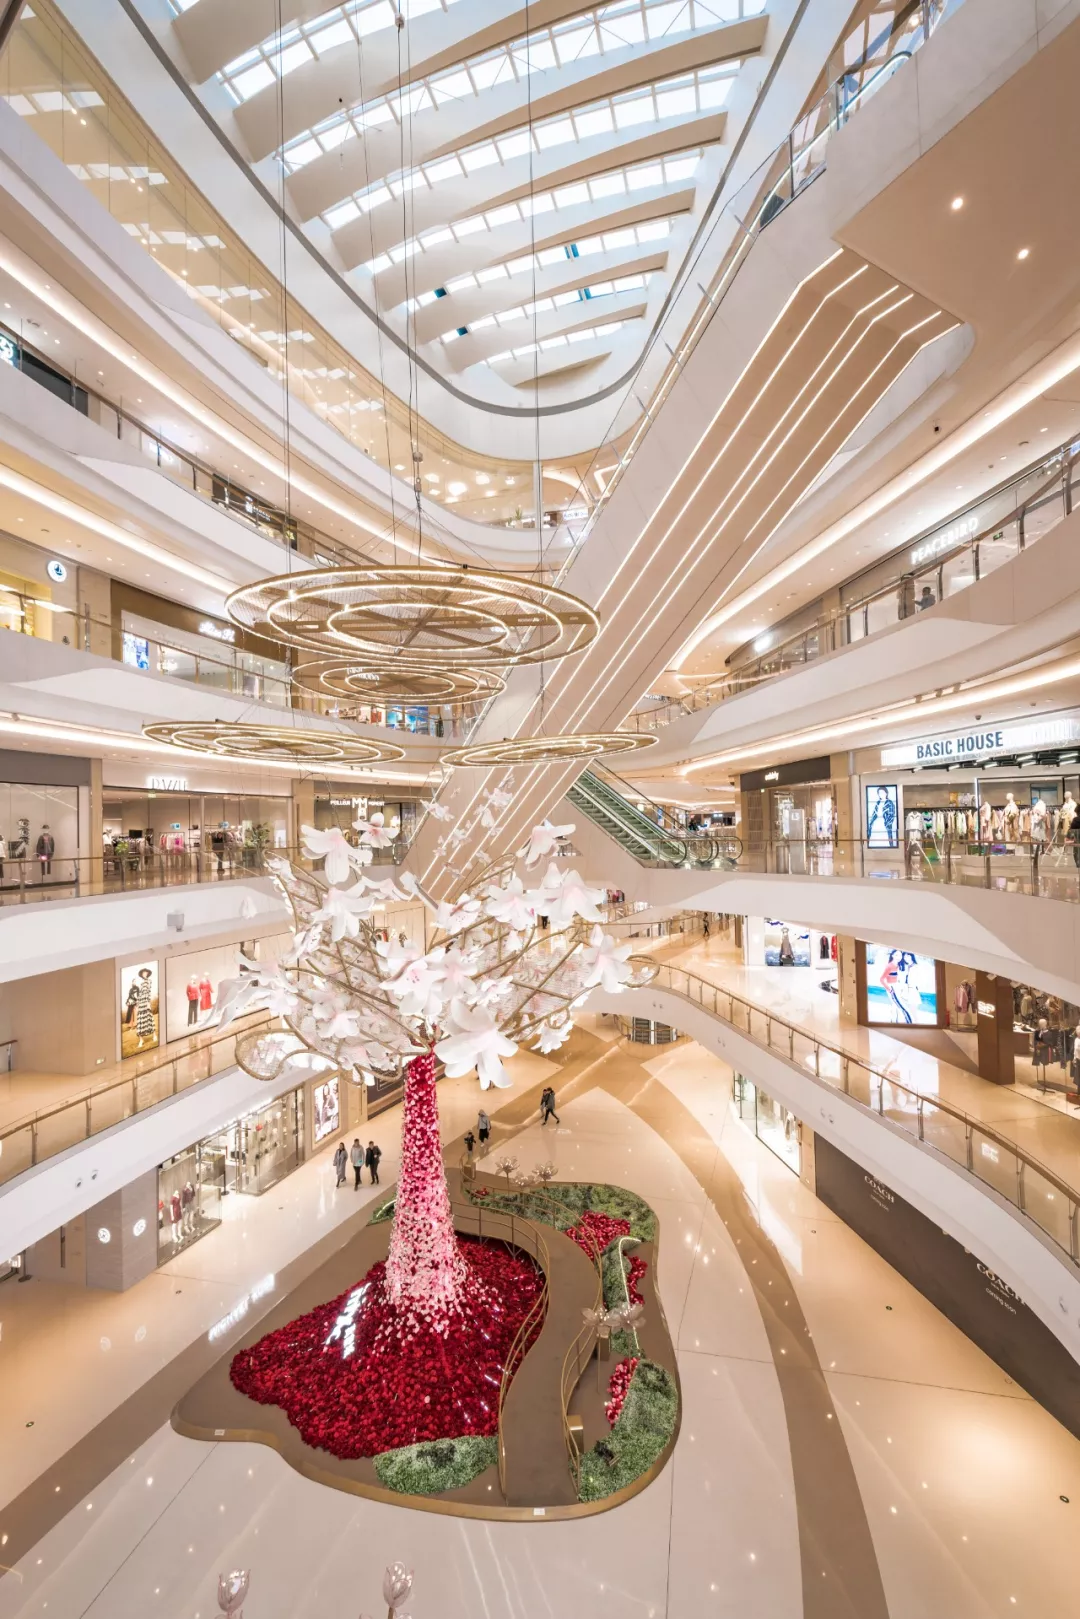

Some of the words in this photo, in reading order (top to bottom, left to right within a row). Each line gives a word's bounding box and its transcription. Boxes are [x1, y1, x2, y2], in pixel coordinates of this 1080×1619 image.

[911, 517, 979, 565] PEACEBIRD
[916, 740, 953, 759] BASIC
[957, 731, 1004, 753] HOUSE
[864, 1175, 894, 1203] COACH
